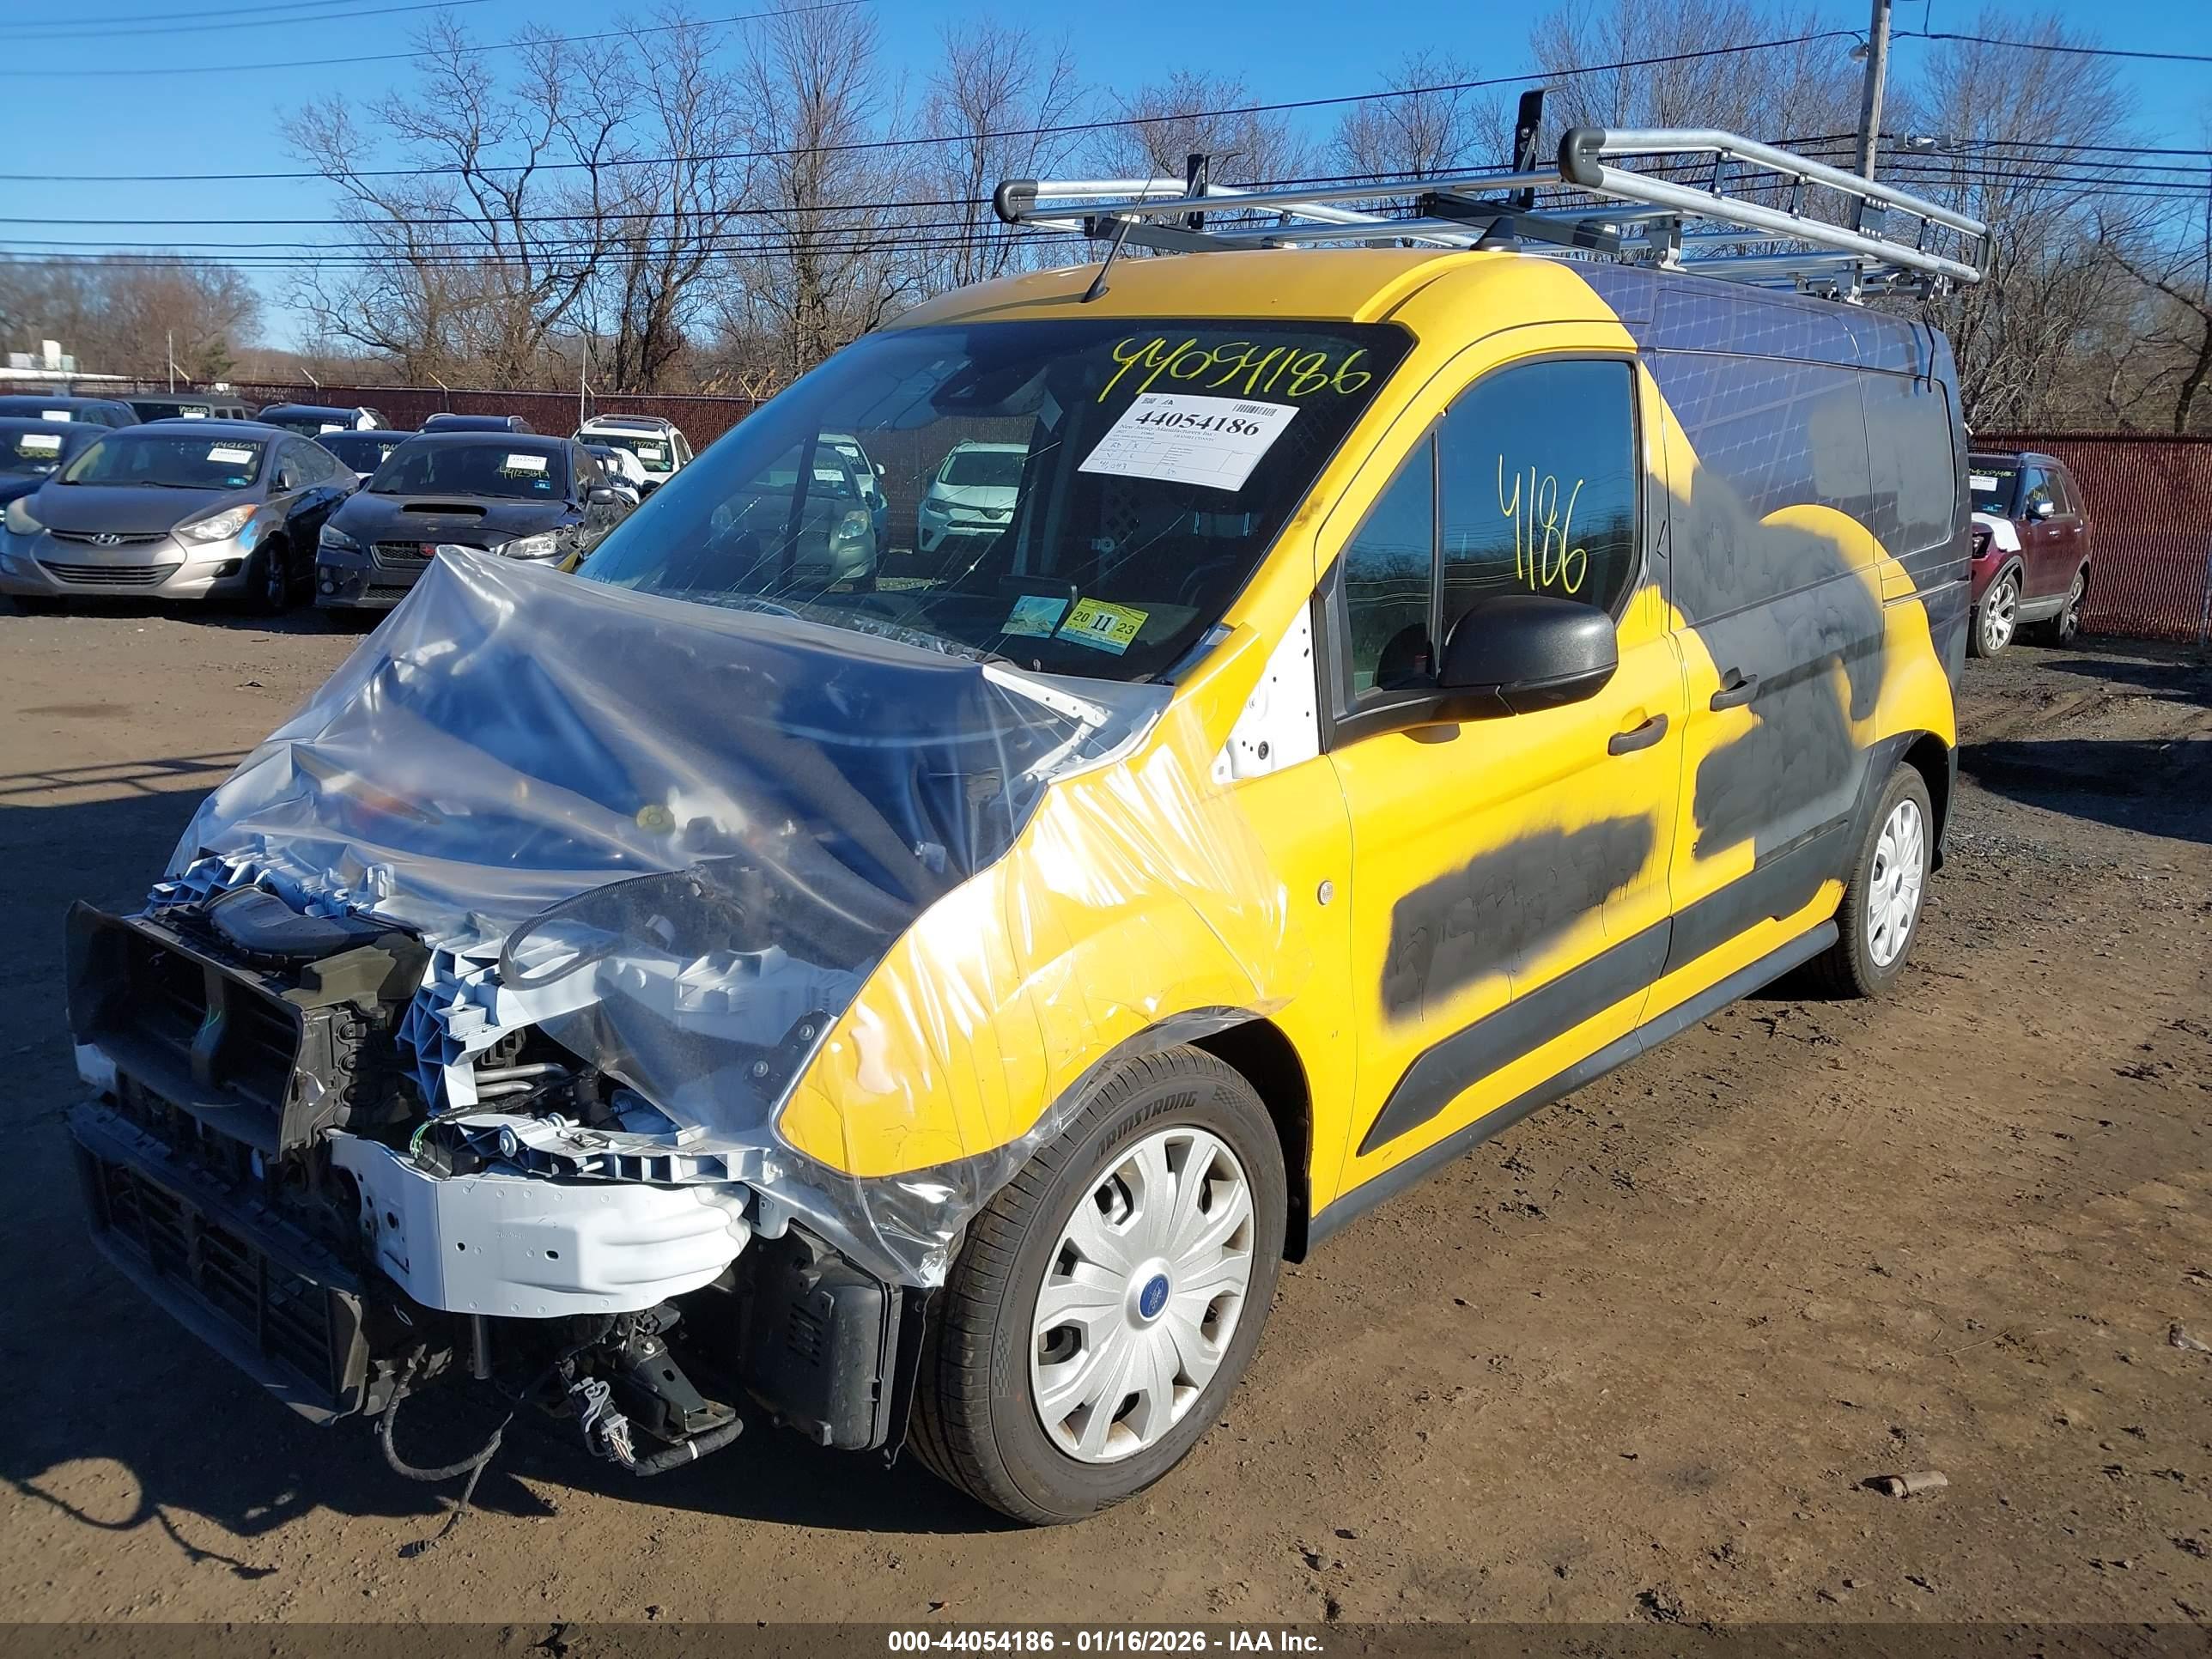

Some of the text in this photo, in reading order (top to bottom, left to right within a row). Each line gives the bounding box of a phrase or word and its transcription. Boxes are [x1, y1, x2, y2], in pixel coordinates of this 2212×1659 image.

[1097, 337, 1371, 404] 44054186
[1134, 410, 1265, 437] 44054186
[1498, 453, 1588, 595] 4186
[1073, 610, 1091, 623] 20
[1091, 613, 1114, 633] 11
[1115, 622, 1136, 635] 23
[1091, 1090, 1199, 1167] ARMSTRONG
